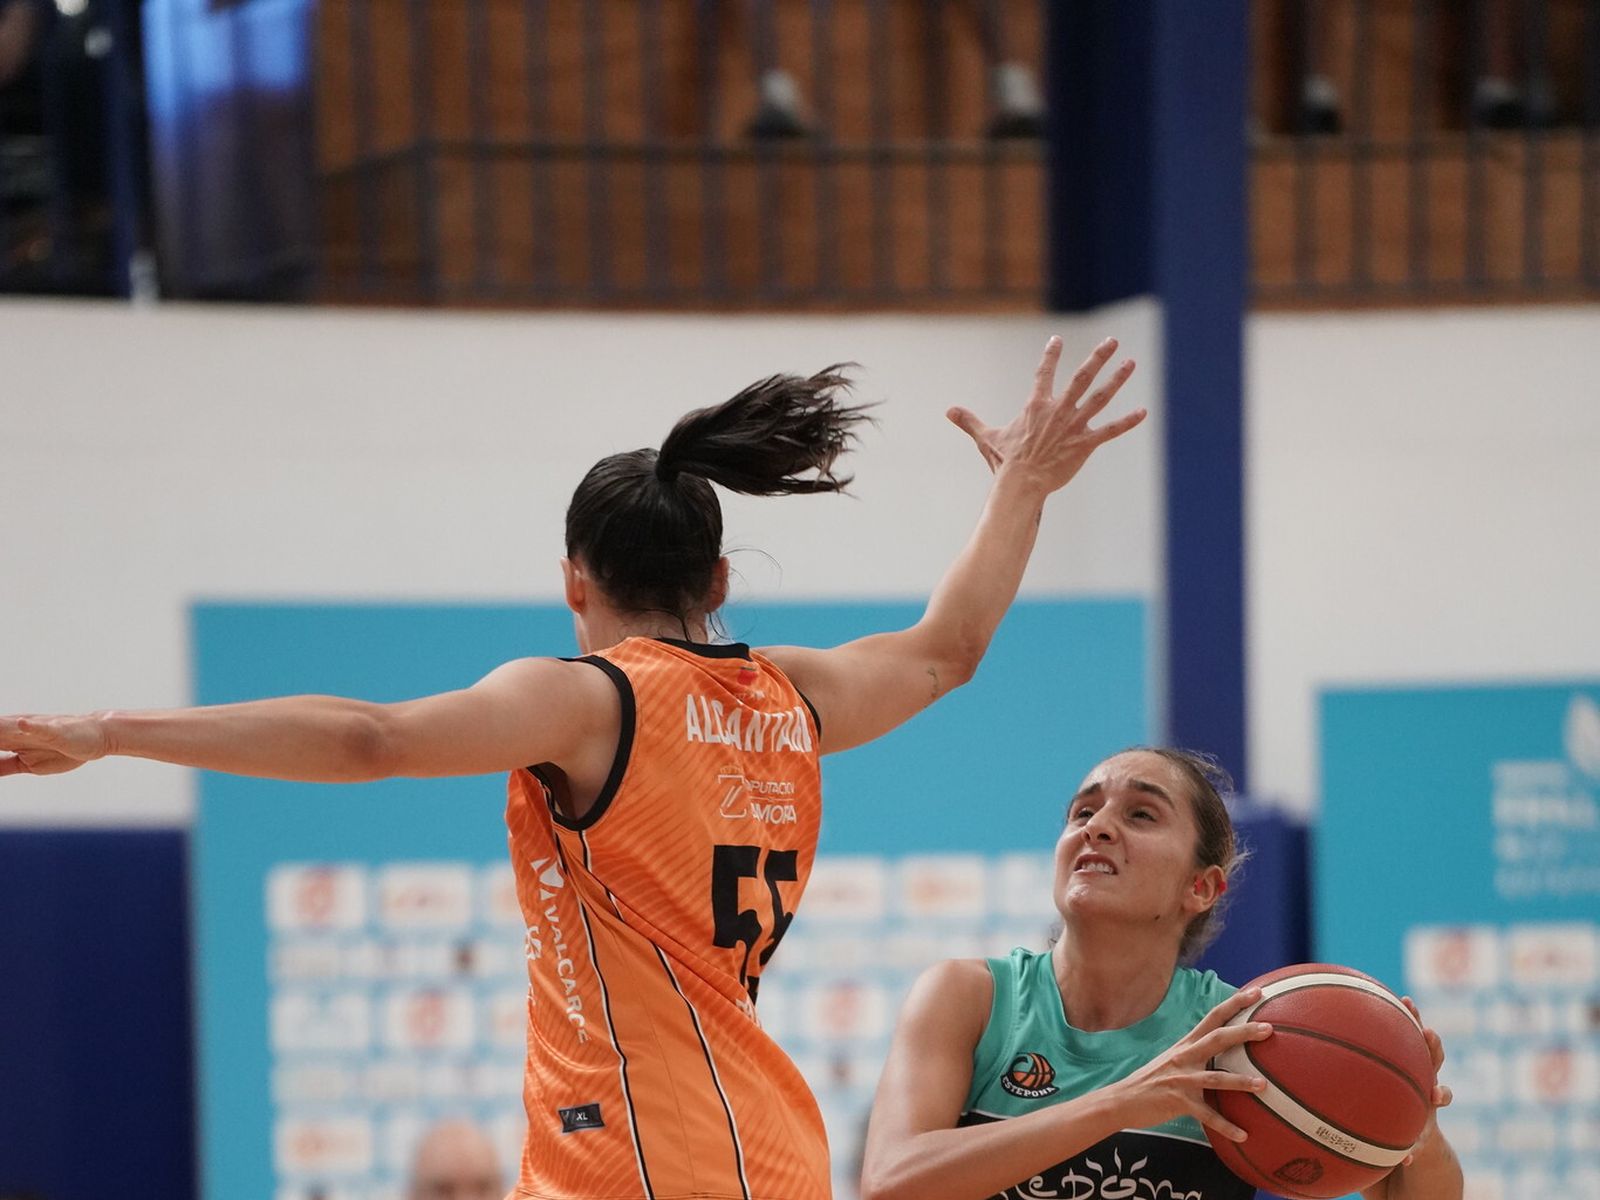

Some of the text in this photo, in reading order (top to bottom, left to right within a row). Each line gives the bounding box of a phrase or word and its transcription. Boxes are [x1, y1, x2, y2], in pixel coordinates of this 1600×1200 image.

[544, 904, 592, 1044] VALCARCE
[1002, 1075, 1055, 1097] ESTEPONA
[576, 1112, 589, 1121] XL
